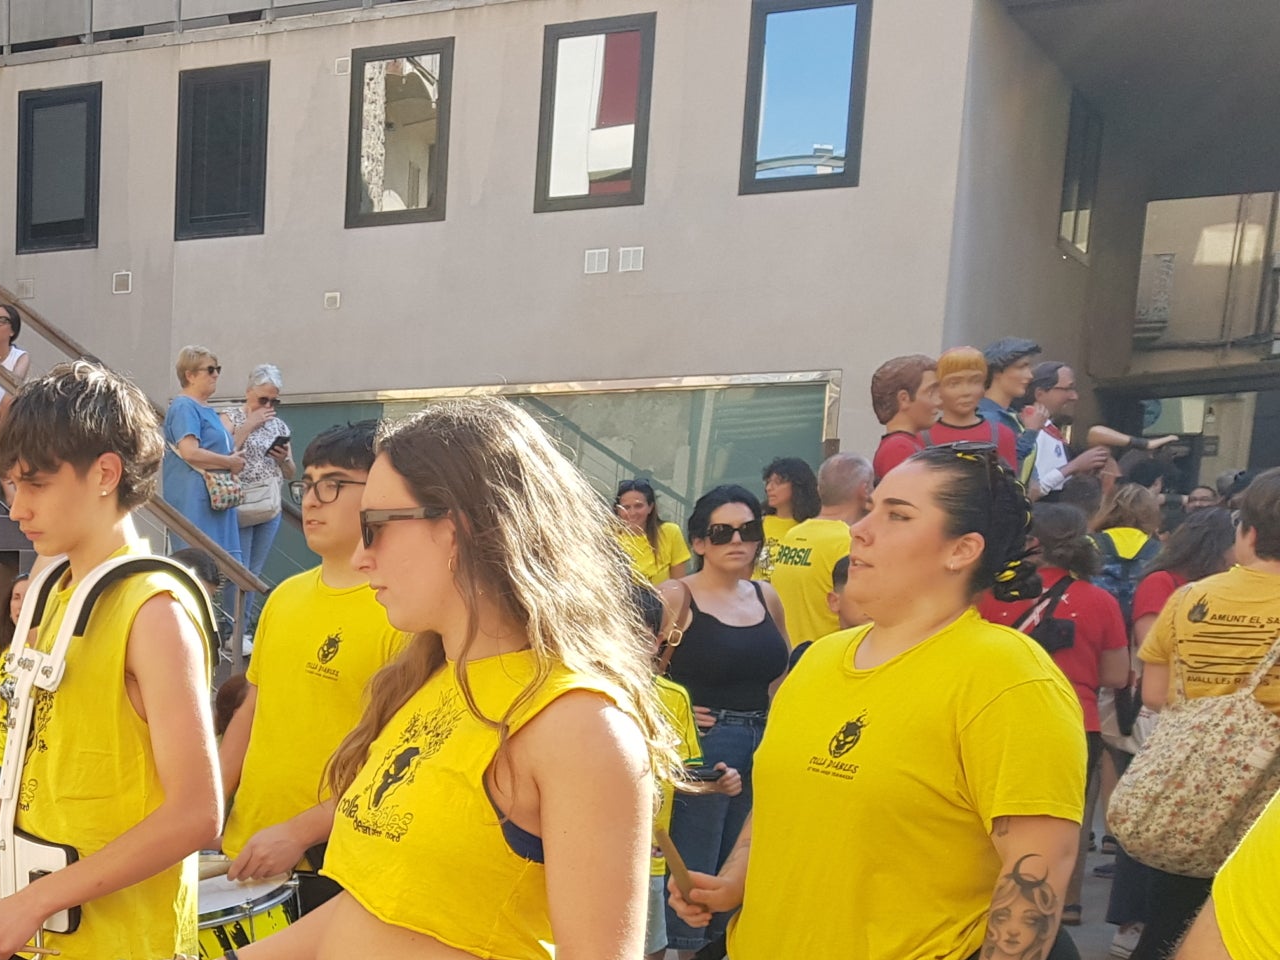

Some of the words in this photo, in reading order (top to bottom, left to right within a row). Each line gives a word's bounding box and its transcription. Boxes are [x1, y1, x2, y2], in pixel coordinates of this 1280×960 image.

[1210, 614, 1247, 623] AMUNT
[1249, 616, 1262, 624] EL
[825, 760, 859, 774] DIABLES
